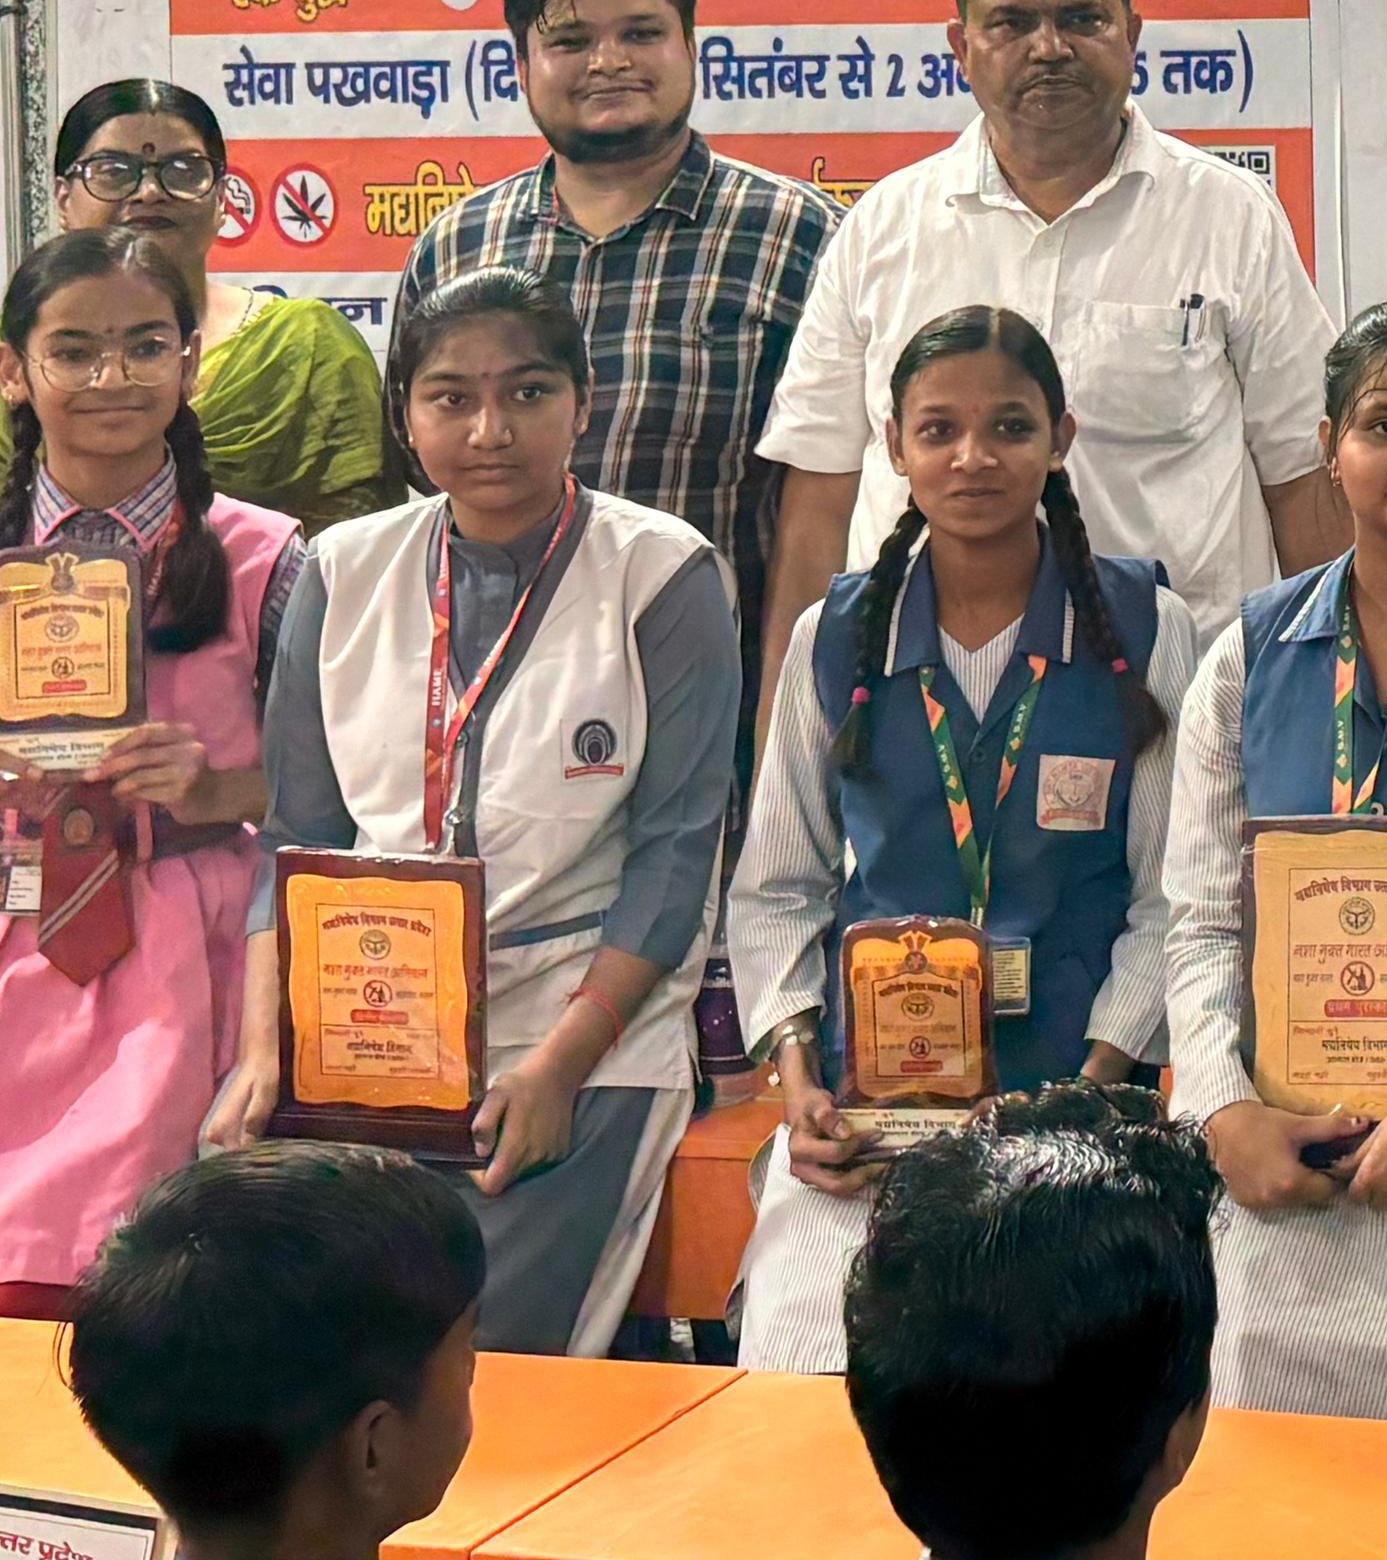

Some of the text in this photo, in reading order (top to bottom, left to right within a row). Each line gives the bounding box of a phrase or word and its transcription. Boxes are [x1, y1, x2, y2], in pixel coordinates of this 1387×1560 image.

[222, 44, 297, 107] सेवा
[303, 60, 451, 120] पखवाड़ा
[700, 36, 831, 101] सितंबर
[836, 41, 876, 99] से
[885, 53, 907, 99] 2
[1160, 30, 1256, 114] तक)
